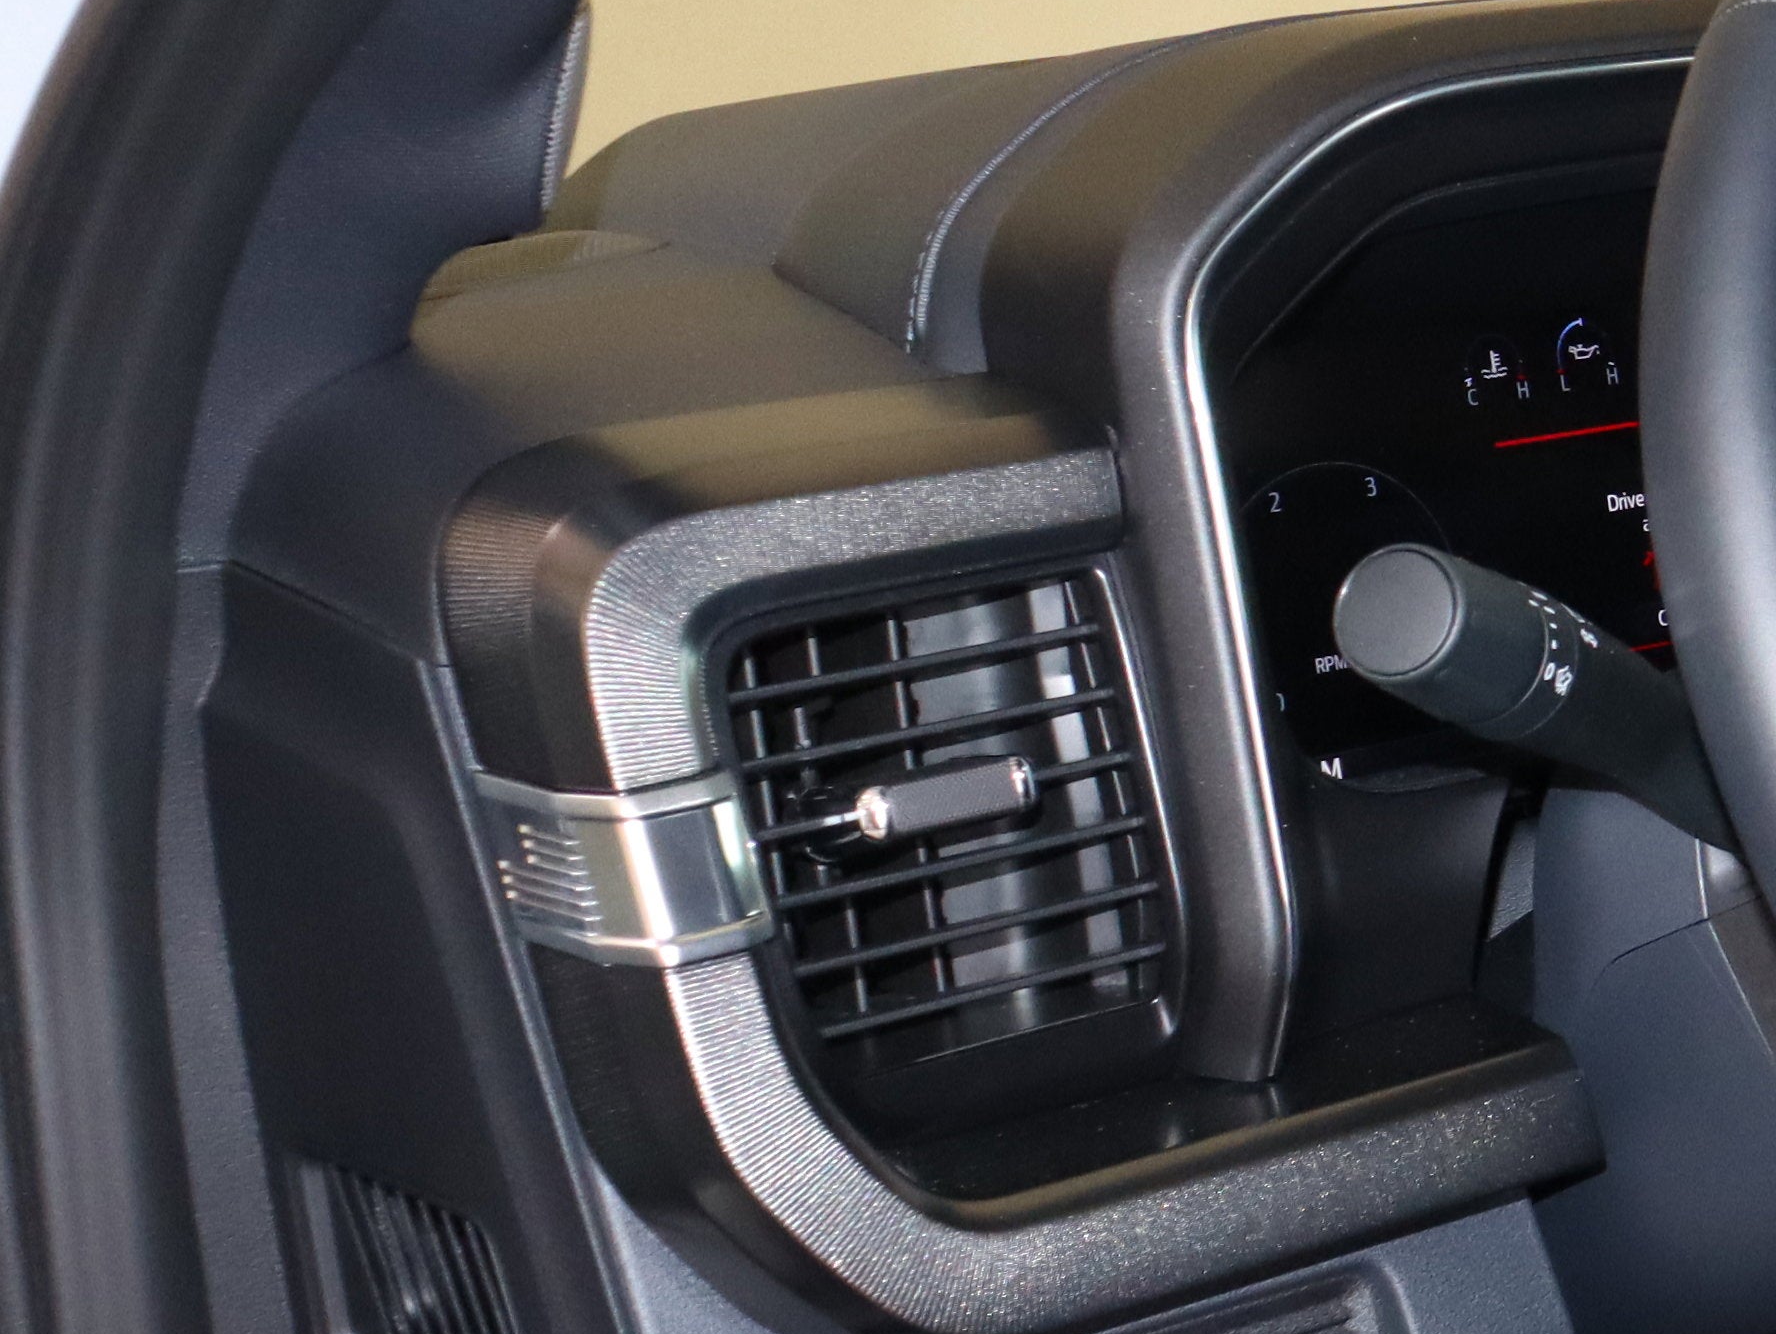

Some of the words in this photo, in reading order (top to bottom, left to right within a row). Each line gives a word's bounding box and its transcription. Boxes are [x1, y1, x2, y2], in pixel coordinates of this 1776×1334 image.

[1560, 375, 1571, 392] L
[1606, 367, 1619, 385] H
[1467, 389, 1479, 406] C
[1517, 380, 1530, 399] H
[1364, 476, 1377, 497] 3
[1268, 491, 1282, 513] 2
